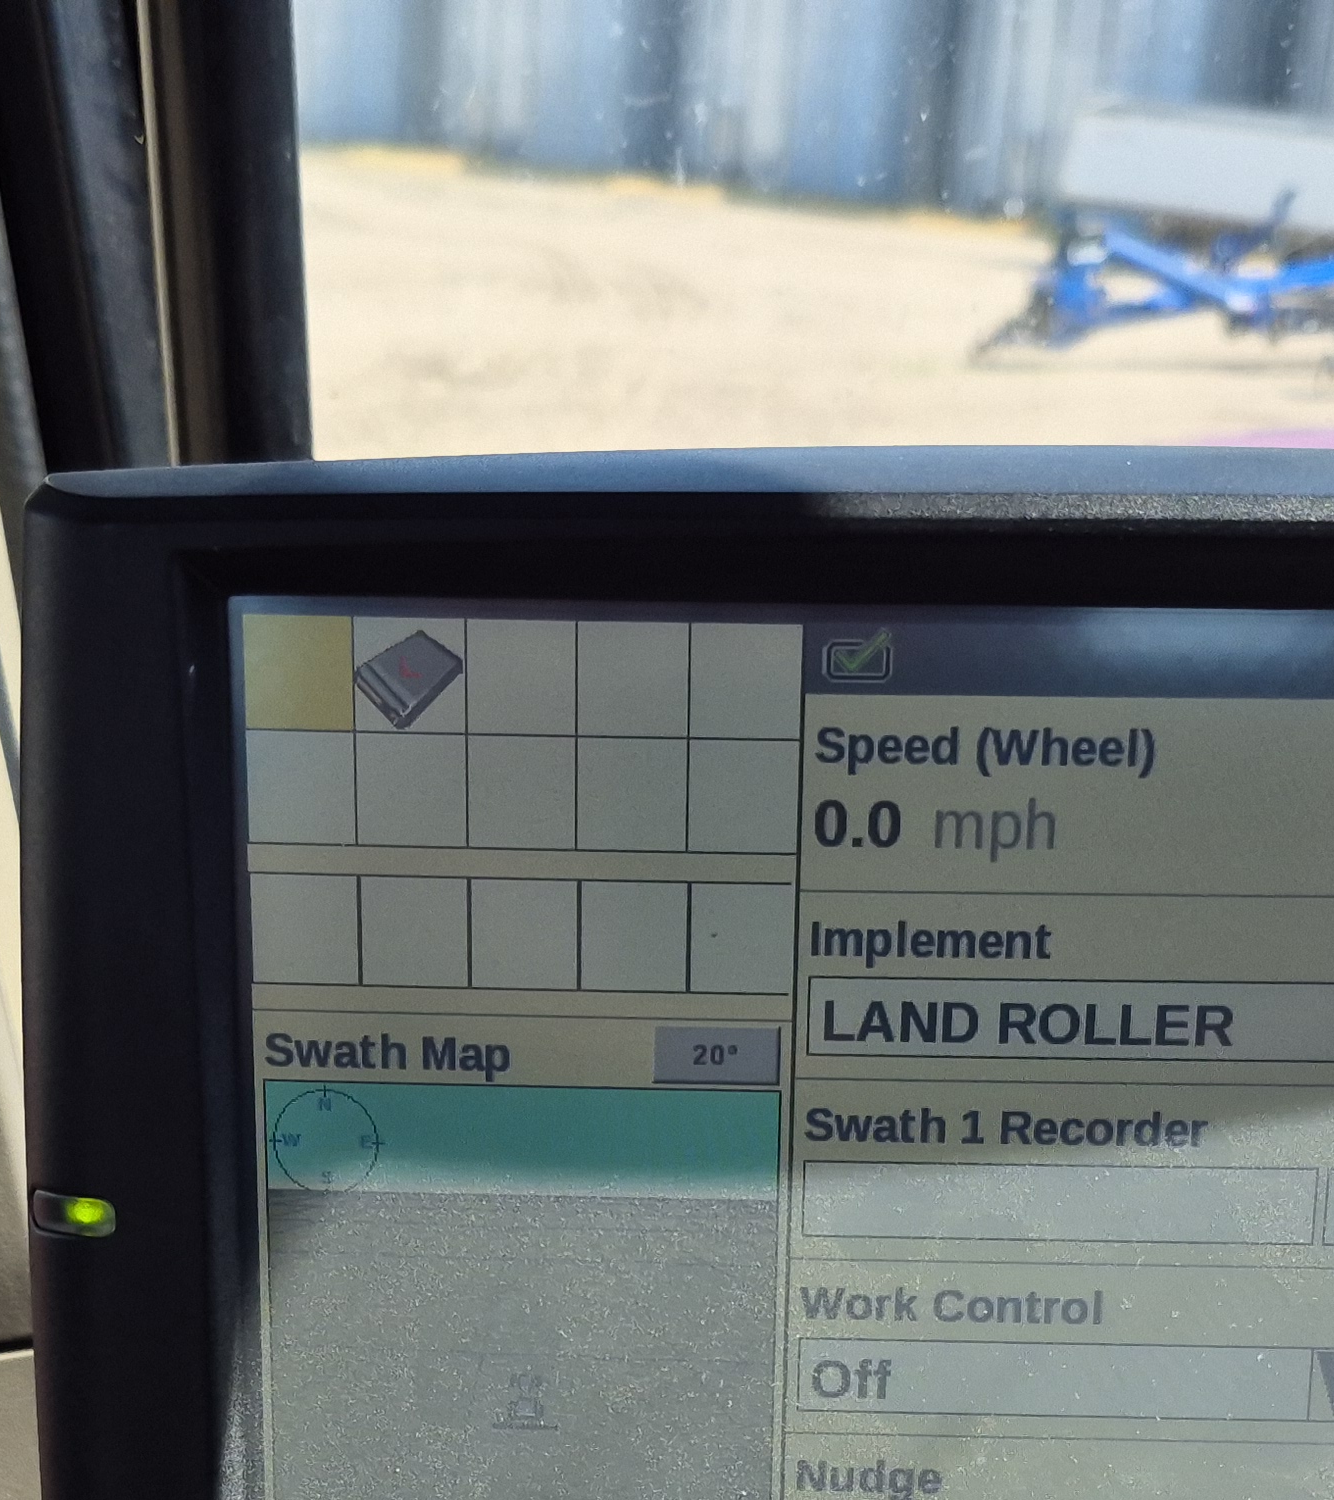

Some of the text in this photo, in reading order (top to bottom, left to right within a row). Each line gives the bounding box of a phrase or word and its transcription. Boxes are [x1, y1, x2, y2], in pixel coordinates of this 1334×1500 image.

[814, 726, 1156, 778] Speed (Wheel)
[814, 797, 1056, 862] 0.0 mph
[810, 921, 1052, 968] Implement
[823, 1001, 1234, 1047] LAND ROLLER
[265, 1032, 511, 1081] Swath Map
[805, 1107, 1209, 1148] Swath 1 Recorder
[801, 1286, 1104, 1325] Work Control
[811, 1358, 892, 1400] Off
